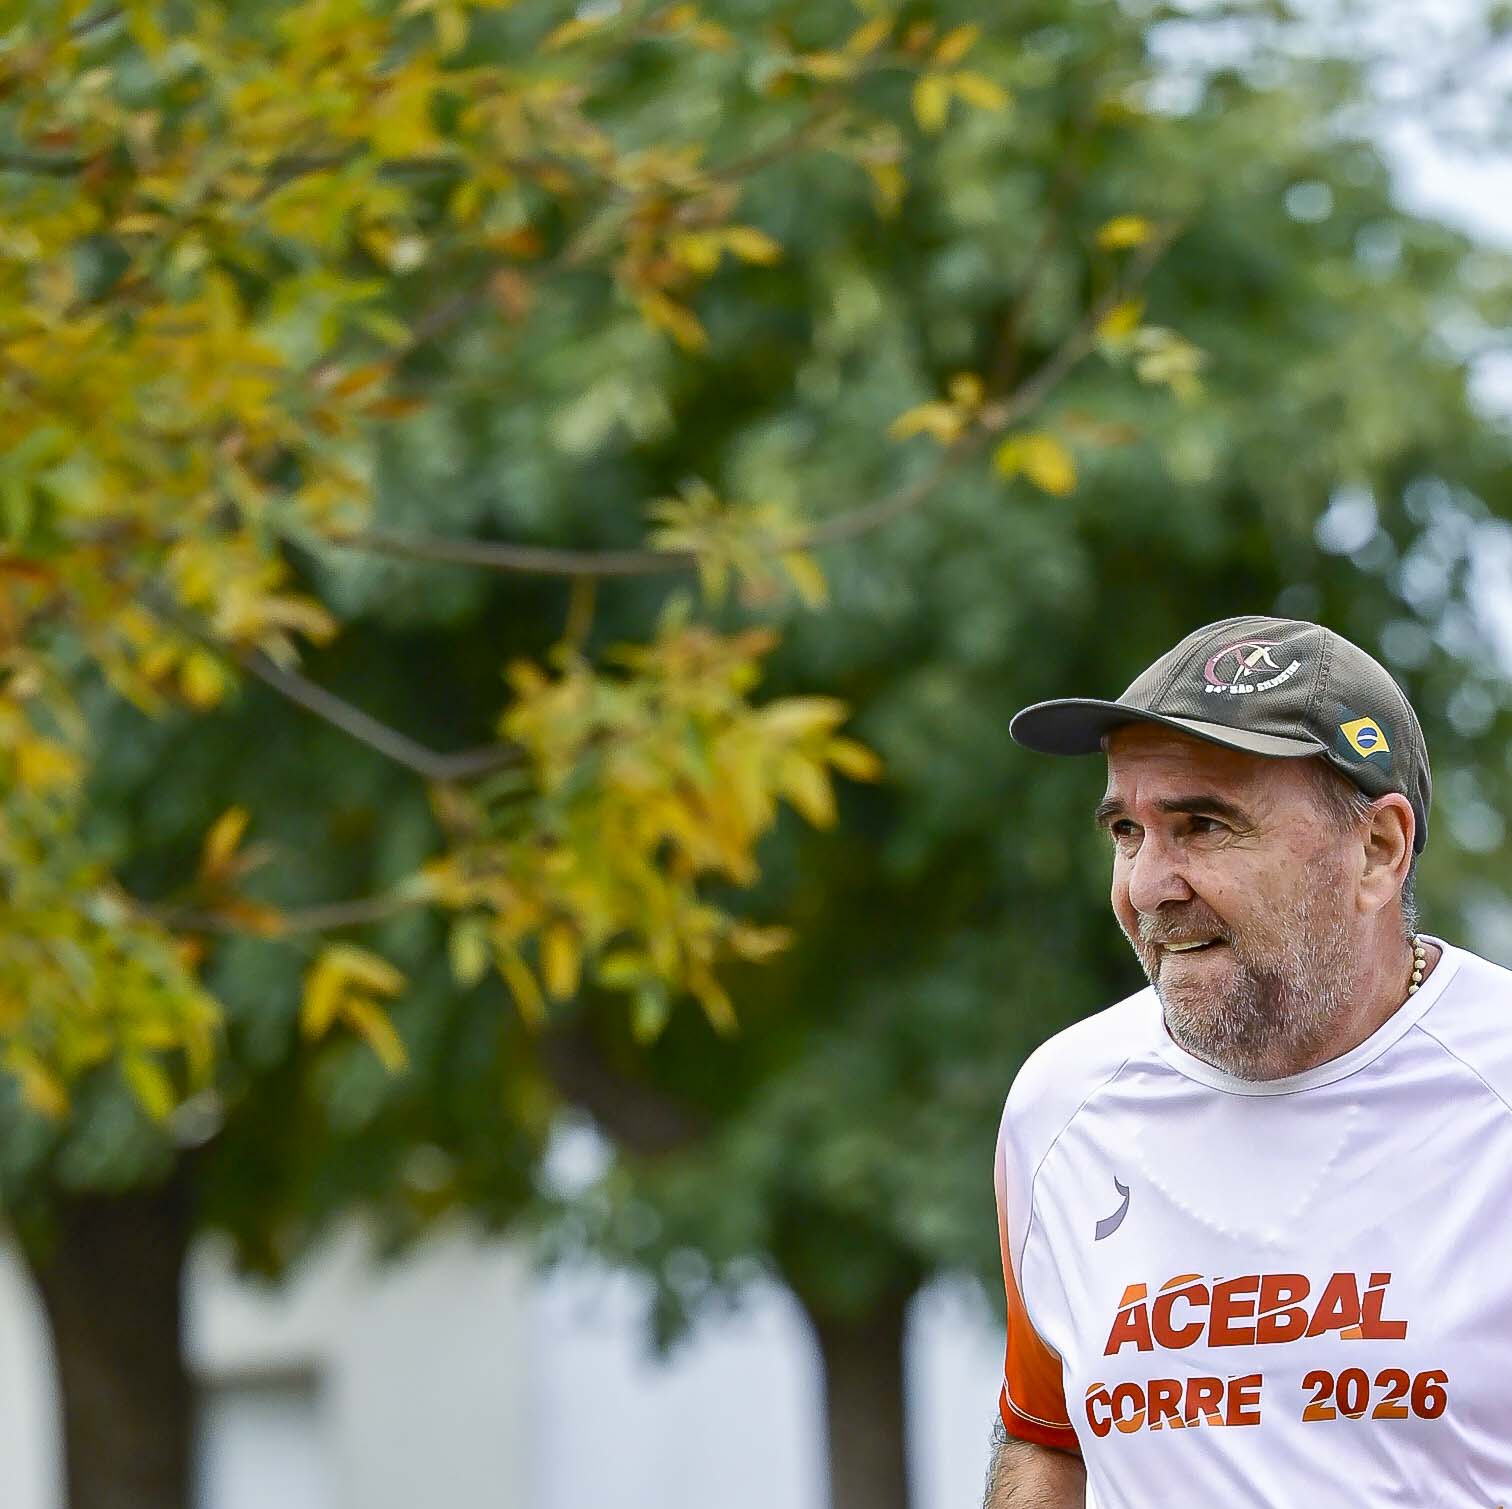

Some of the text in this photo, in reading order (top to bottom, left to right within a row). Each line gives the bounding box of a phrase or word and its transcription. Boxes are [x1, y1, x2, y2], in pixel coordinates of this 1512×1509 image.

[1103, 1272, 1408, 1356] ACEBAL
[1085, 1367, 1450, 1438] CORRE 2026
